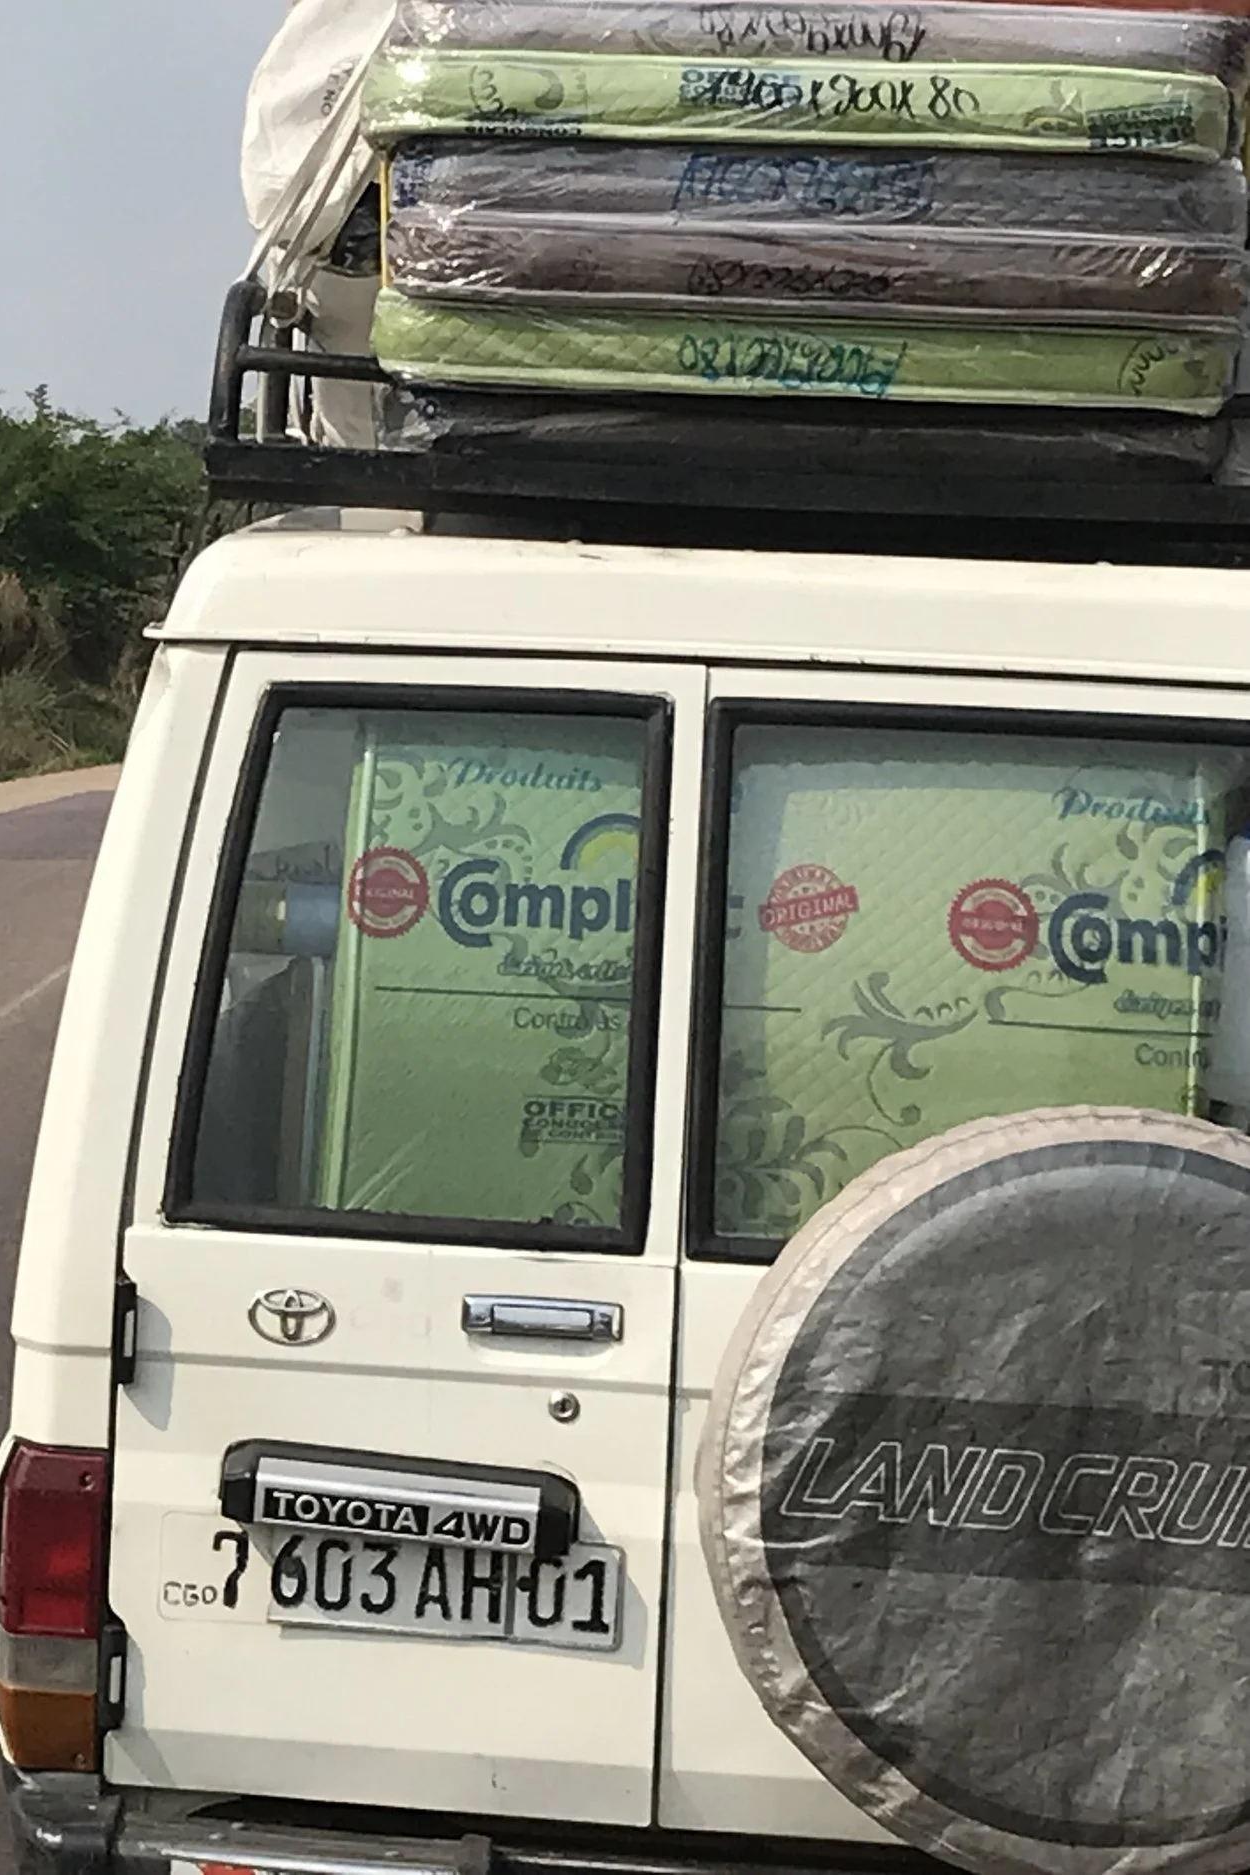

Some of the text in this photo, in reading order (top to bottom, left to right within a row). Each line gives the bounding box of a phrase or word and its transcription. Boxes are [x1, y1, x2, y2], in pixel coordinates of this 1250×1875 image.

[448, 757, 603, 792] Produits
[762, 891, 854, 925] ORIGINAL
[779, 1438, 1250, 1550] LAND CRUI
[272, 1491, 531, 1546] TOYOTA 4WD
